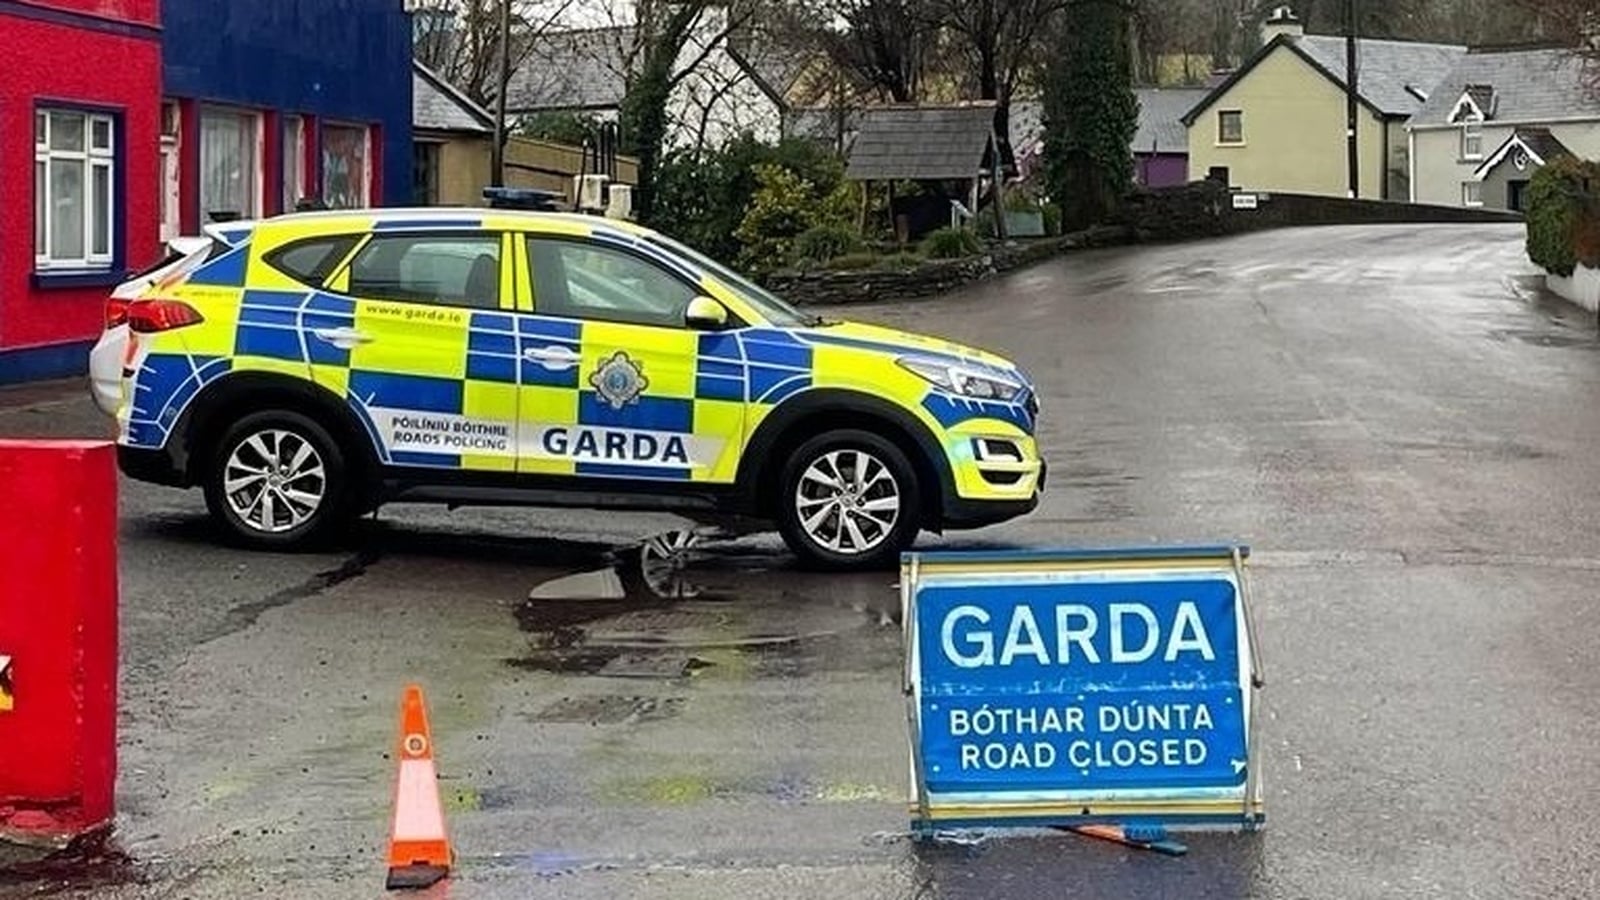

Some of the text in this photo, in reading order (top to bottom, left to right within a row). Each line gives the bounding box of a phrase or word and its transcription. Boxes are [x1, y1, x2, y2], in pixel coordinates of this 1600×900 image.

[392, 416, 507, 436] PÓILÍNIÚ BÓITHRE
[394, 431, 507, 450] ROADS POLICING
[542, 427, 689, 463] GARDA
[940, 601, 1216, 668] GARDA
[950, 701, 1214, 735] BÓTHAR DÚNTA
[961, 739, 1208, 770] ROAD CLOSED
